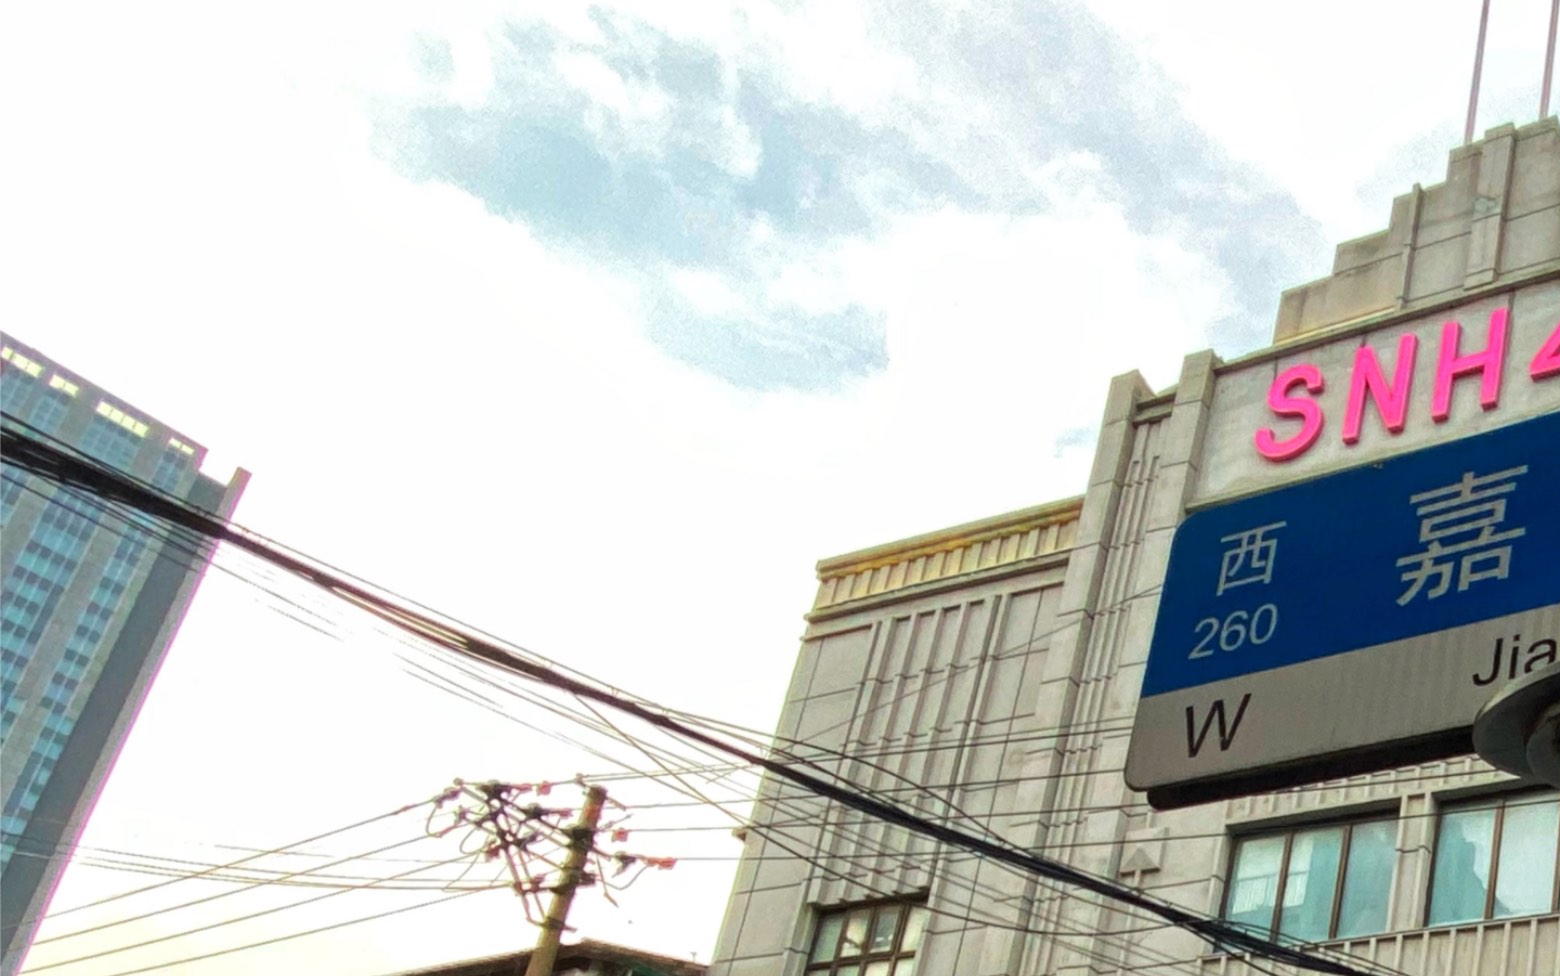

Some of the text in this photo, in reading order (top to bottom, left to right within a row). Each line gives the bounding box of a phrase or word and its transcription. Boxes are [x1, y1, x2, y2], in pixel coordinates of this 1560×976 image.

[1215, 520, 1287, 597] 西
[1187, 603, 1278, 660] 260
[1183, 693, 1252, 759] W
